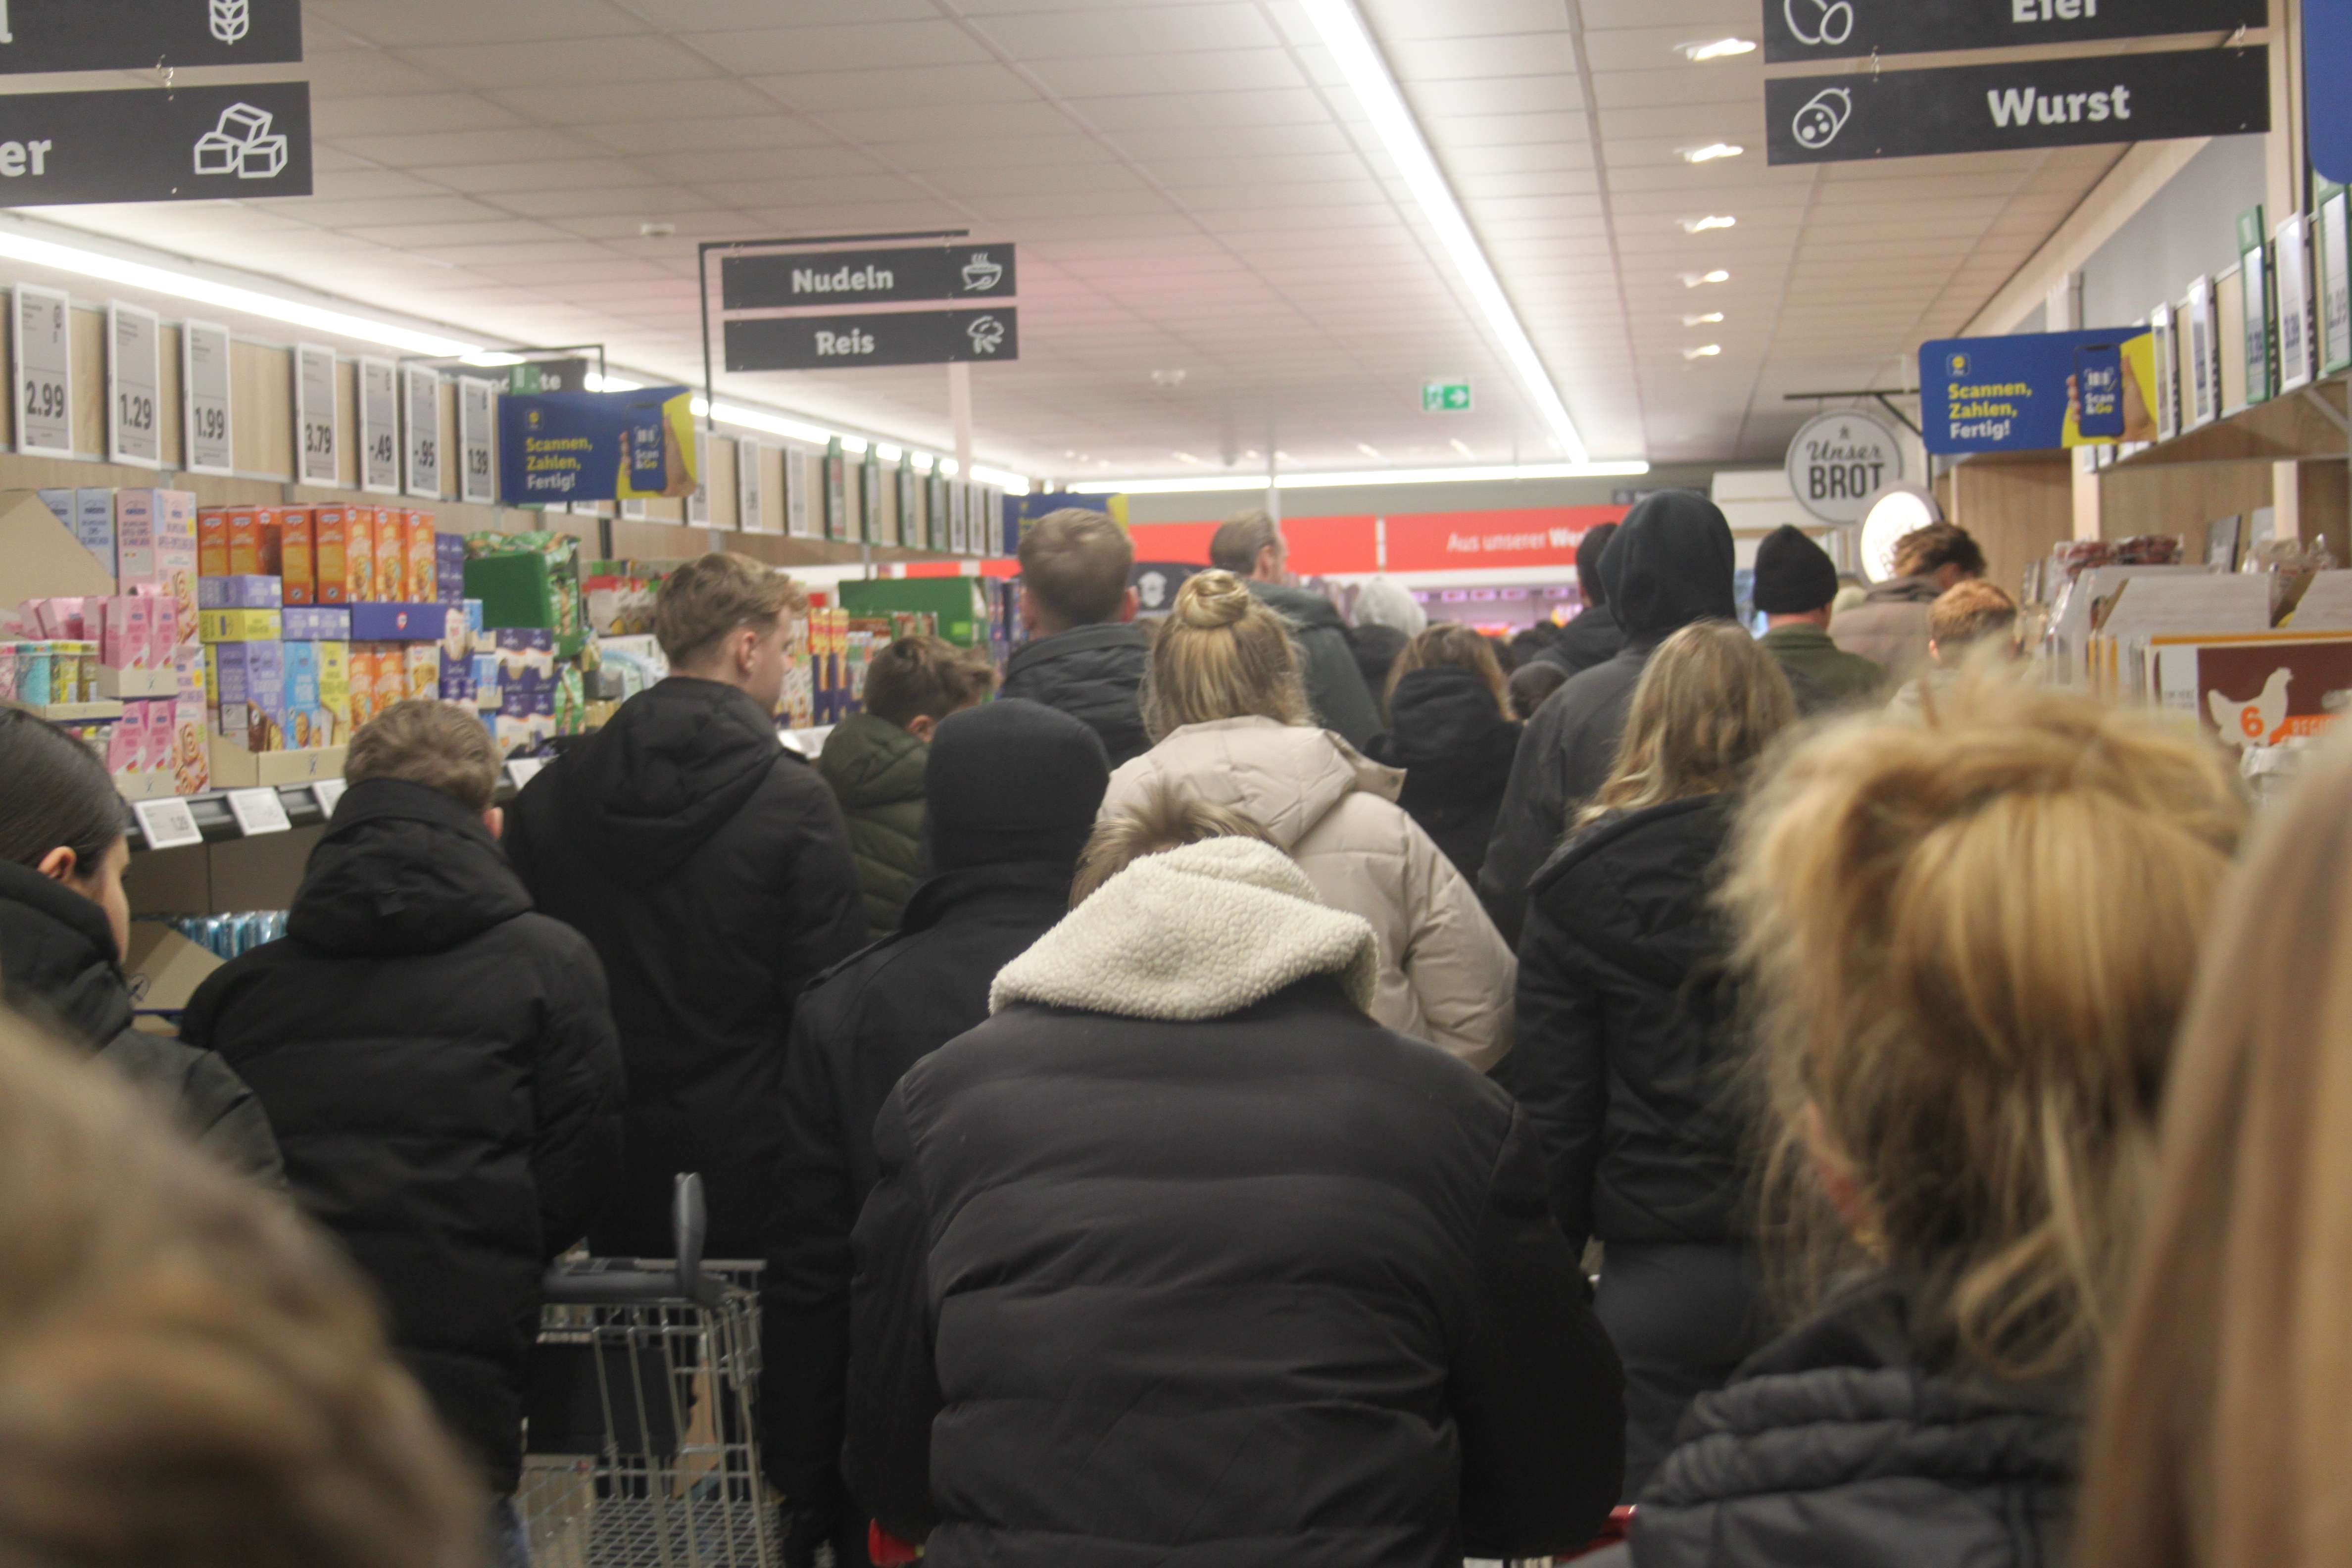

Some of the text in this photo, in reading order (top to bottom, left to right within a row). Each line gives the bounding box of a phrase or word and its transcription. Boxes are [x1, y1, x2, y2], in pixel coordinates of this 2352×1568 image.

[1987, 85, 2131, 128] Wurst
[792, 265, 894, 294] Nudeln
[815, 328, 875, 355] Reis
[26, 380, 64, 419] 2.99
[1948, 382, 2033, 400] Scannen,
[2085, 392, 2115, 403] Scan
[120, 393, 151, 430] 1.29
[1949, 400, 2018, 420] Zahlen,
[196, 407, 225, 440] 1.99
[1950, 419, 2010, 441] Fertig!
[306, 423, 331, 454] 3.79
[525, 436, 593, 452] Scannen,
[1806, 440, 1881, 461] Unser
[527, 454, 582, 471] Zahlen,
[527, 472, 576, 492] Fertig!
[1810, 462, 1886, 499] BROT
[1446, 531, 1480, 553] Aus
[2241, 706, 2264, 738] 6
